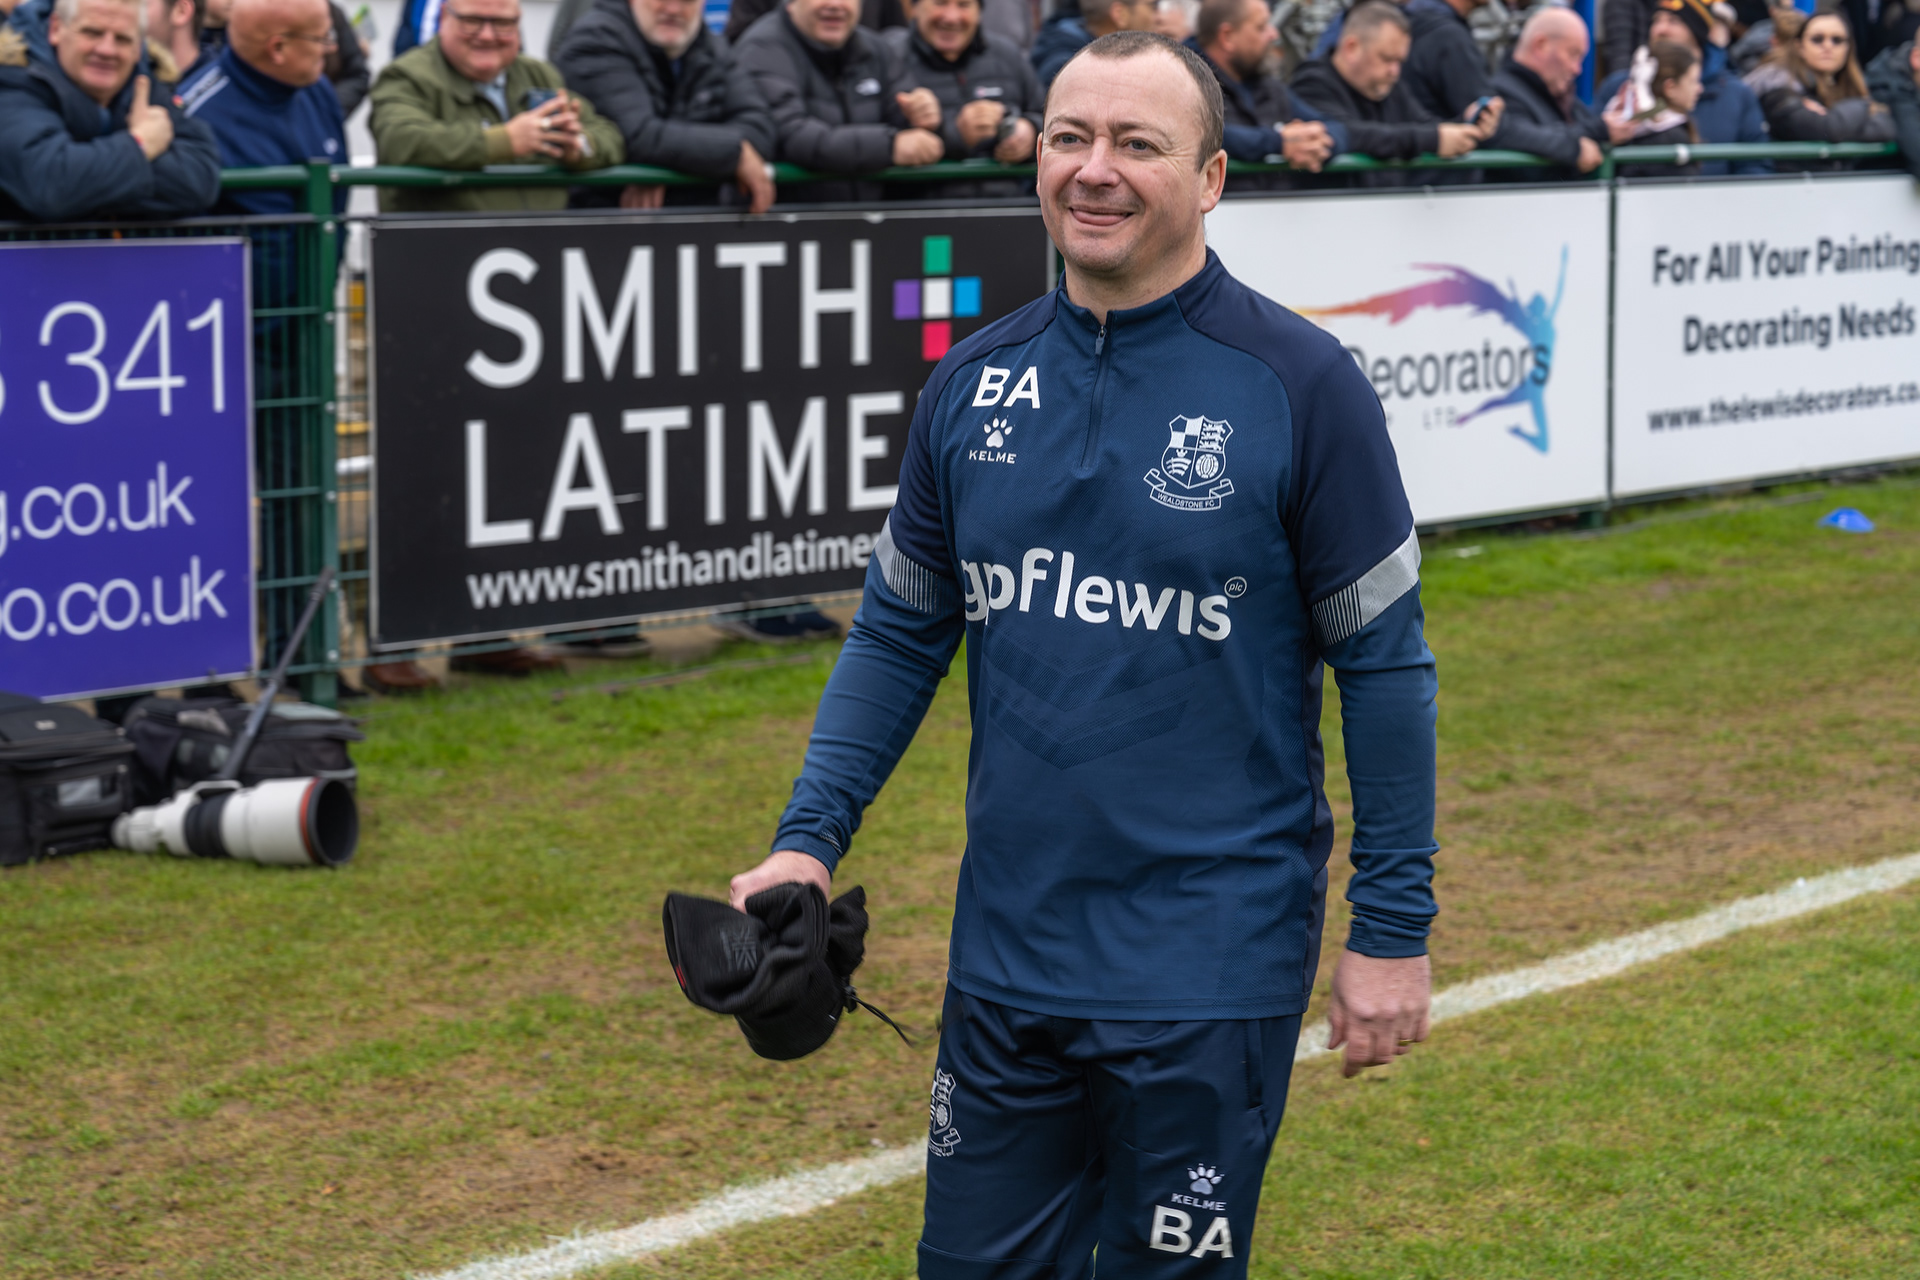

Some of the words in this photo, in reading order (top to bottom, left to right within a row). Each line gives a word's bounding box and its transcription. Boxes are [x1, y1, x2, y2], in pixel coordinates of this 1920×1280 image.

[1652, 246, 1700, 284] For
[1706, 241, 1742, 282] All
[1750, 239, 1810, 278] Your
[1816, 232, 1920, 275] Painting
[465, 239, 873, 388] SMITH
[1683, 306, 1832, 353] Decorating
[1838, 299, 1916, 341] Needs
[38, 298, 225, 425] 341
[971, 365, 1041, 409] BA
[465, 390, 923, 547] LATIME
[968, 449, 1017, 464] KELME
[0, 461, 195, 557] .co.uk
[1157, 492, 1203, 508] WEALDSTONE
[1205, 500, 1214, 508] FC
[466, 529, 881, 609] www.smithandlatime
[960, 547, 1232, 641] gpflewis
[1171, 1193, 1227, 1211] KELME
[1149, 1205, 1234, 1258] BA
